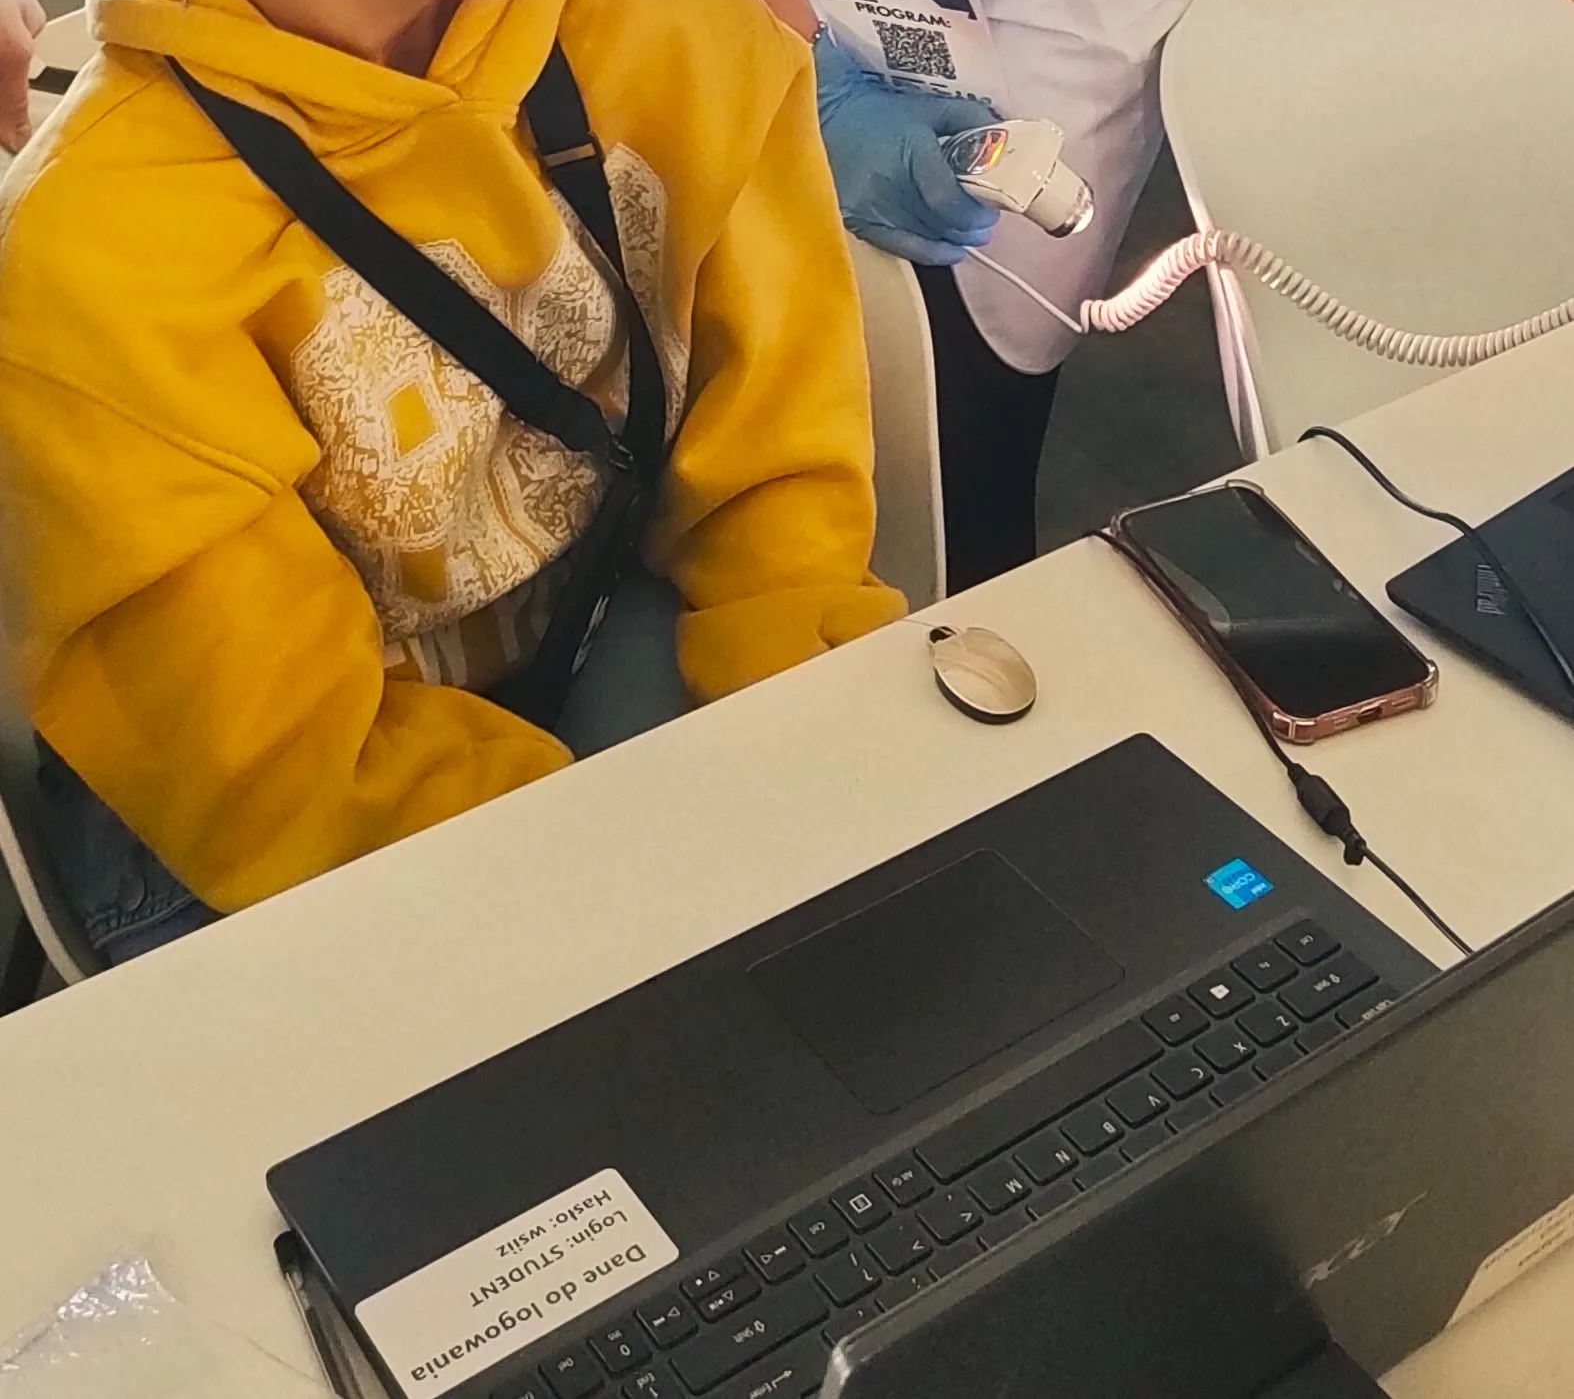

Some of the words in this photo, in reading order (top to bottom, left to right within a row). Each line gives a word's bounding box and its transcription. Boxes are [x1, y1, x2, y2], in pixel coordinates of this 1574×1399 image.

[855, 2, 952, 28] PROGRAM:
[1275, 1015, 1291, 1027] Z
[1232, 1041, 1247, 1054] X
[1190, 1067, 1204, 1079] C
[1148, 1095, 1162, 1108] V
[1102, 1121, 1116, 1134] B
[1055, 1150, 1071, 1164] N
[1004, 1178, 1023, 1194] M
[565, 1210, 629, 1249] Login:
[496, 1224, 548, 1258] wsiiz
[582, 1244, 647, 1284] Dane
[469, 1244, 566, 1308] STUDENT
[545, 1280, 578, 1303] do
[410, 1301, 545, 1383] logowania
